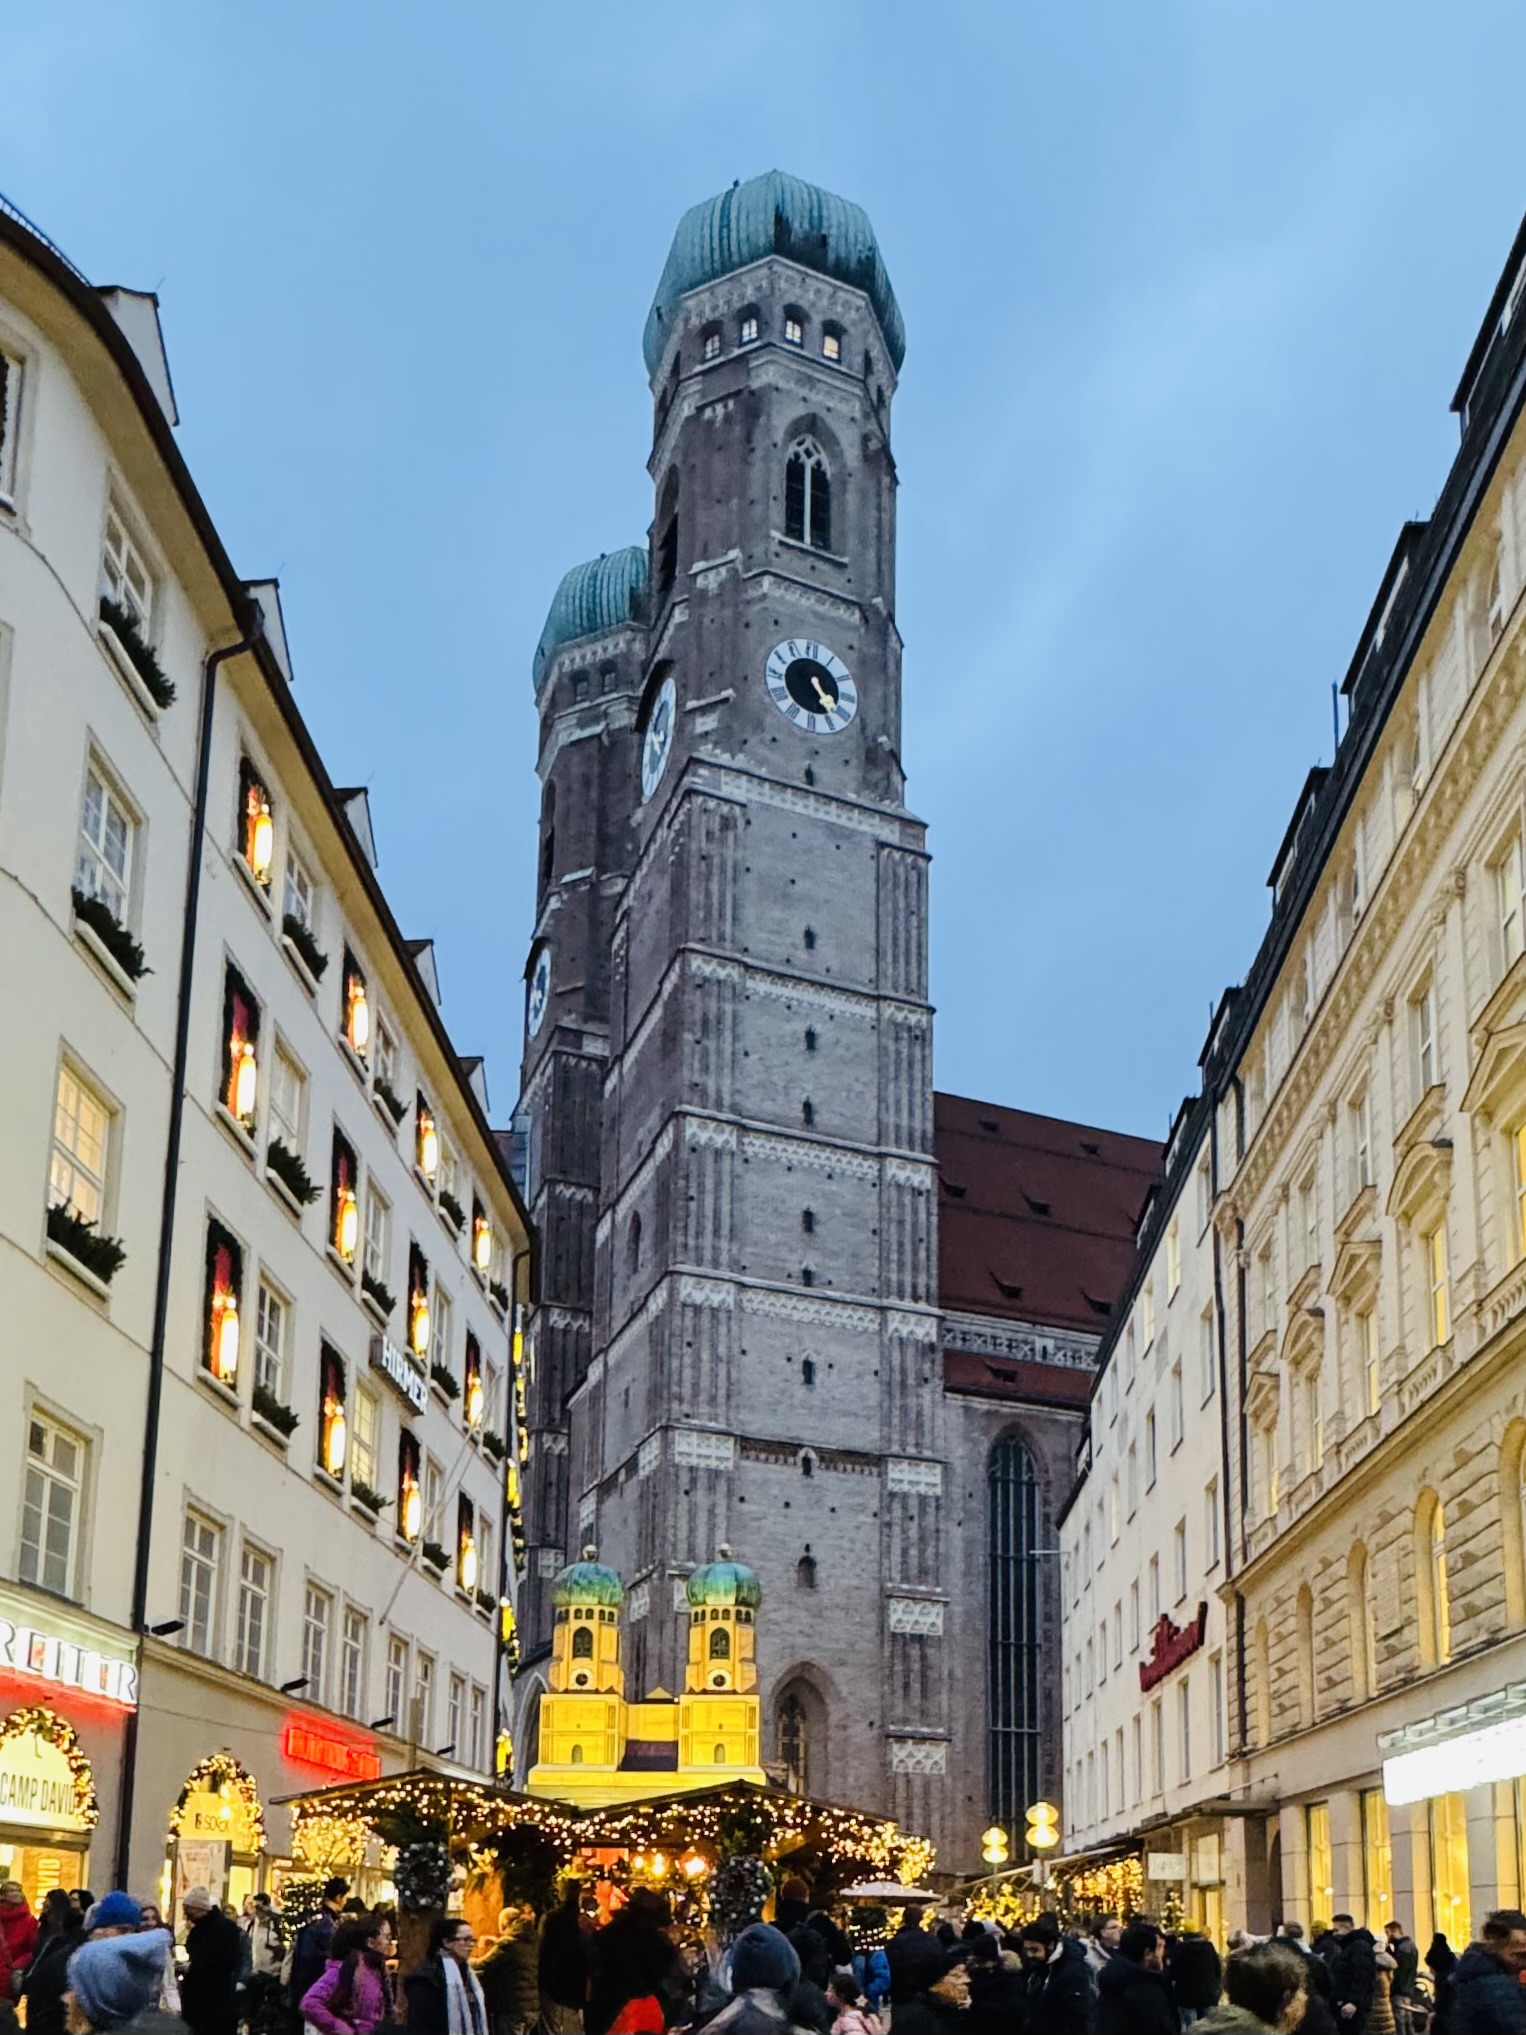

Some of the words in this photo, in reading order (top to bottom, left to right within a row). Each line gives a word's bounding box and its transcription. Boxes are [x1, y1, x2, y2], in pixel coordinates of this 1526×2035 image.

[382, 1335, 428, 1416] HIRMER
[0, 1772, 38, 1810] CAMP
[40, 1780, 76, 1815] DAVID
